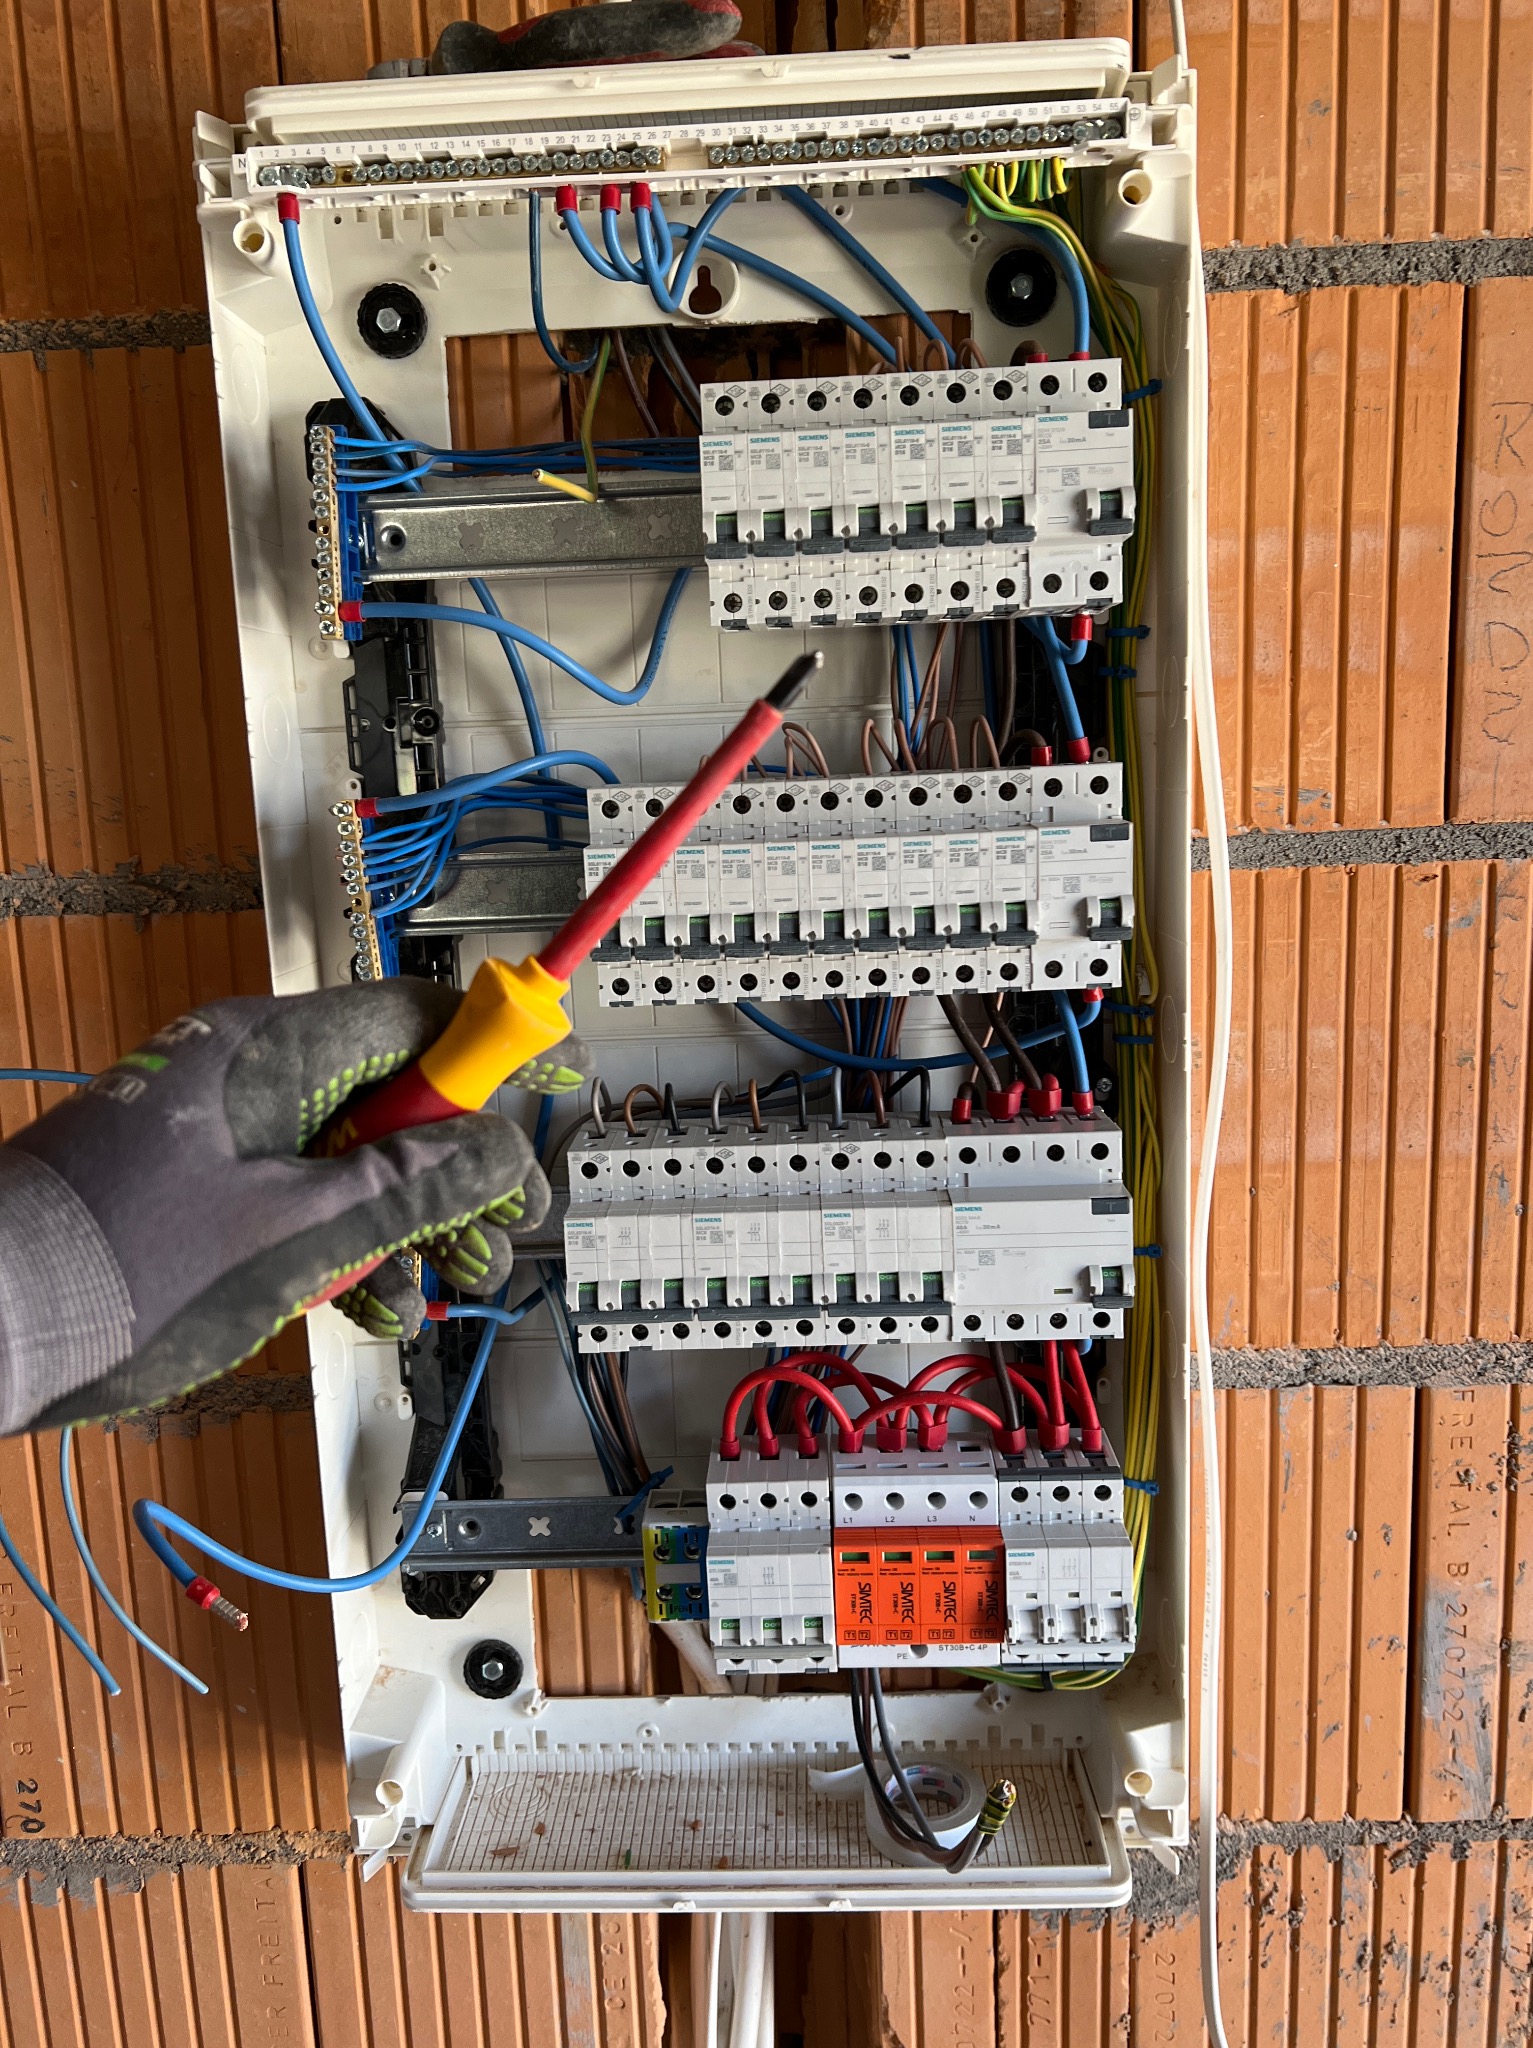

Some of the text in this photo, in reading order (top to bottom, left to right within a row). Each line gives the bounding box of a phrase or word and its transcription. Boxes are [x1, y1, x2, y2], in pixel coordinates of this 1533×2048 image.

[238, 102, 1119, 168] N 1 2 3 4 5 6 7 8 9 10 11 12 13 14 15 16 17 18 19 20 21 22 23 24 25 26 27 28 29 30 31 32 33 34 35 36 37 38 39 40 41 42 43 44 45 46 47 48 49 50 51 52 53 54 55
[845, 431, 876, 439] SIEMENS
[1447, 1562, 1469, 1578] B
[858, 1582, 874, 1624] SIMTEC
[900, 1581, 915, 1624] SIMTEC
[942, 1580, 958, 1623] SIMTEC
[985, 1580, 999, 1622] SIMTEC
[15, 1779, 46, 1834] 270
